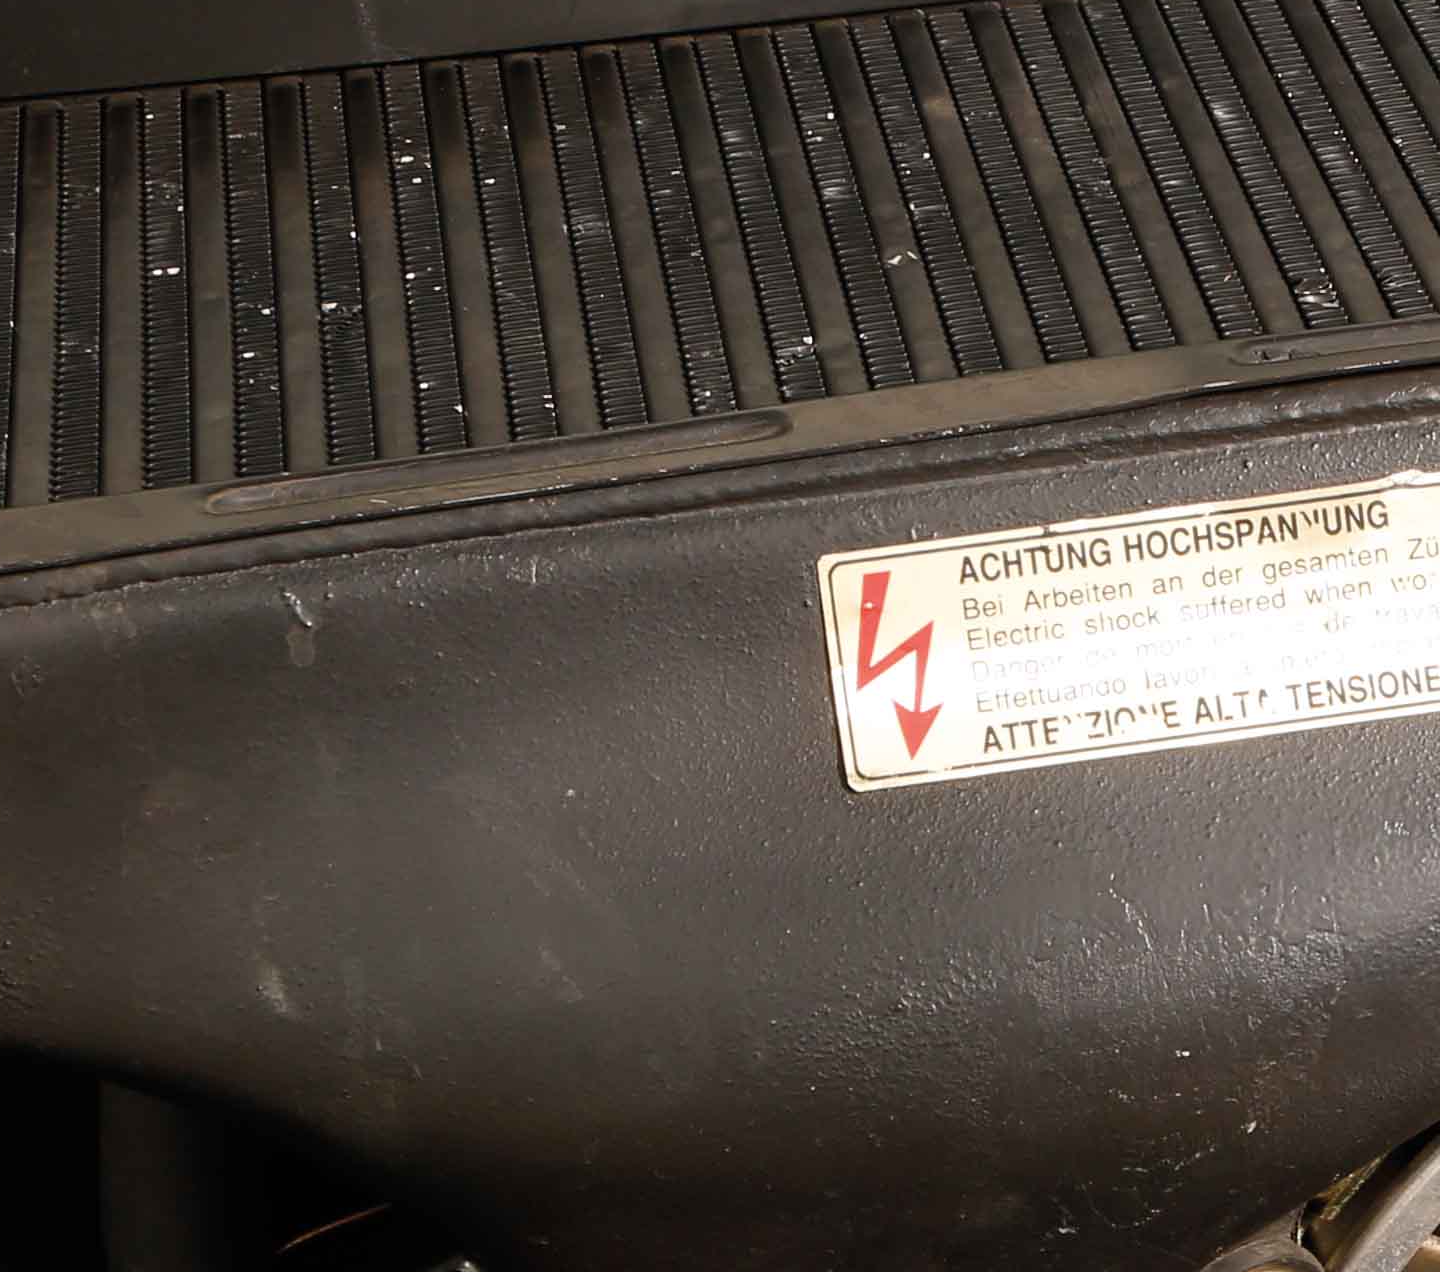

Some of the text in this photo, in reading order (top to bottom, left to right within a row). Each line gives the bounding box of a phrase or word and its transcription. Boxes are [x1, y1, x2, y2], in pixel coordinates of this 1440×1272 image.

[956, 536, 1112, 585] ACHTUNG
[962, 594, 1004, 620] Bei
[1022, 577, 1133, 611] Arbeiten
[1151, 576, 1183, 595] an
[1201, 561, 1243, 588] der
[1261, 544, 1390, 585] gesamten
[966, 617, 1065, 651] Electric
[1083, 605, 1159, 636] shock
